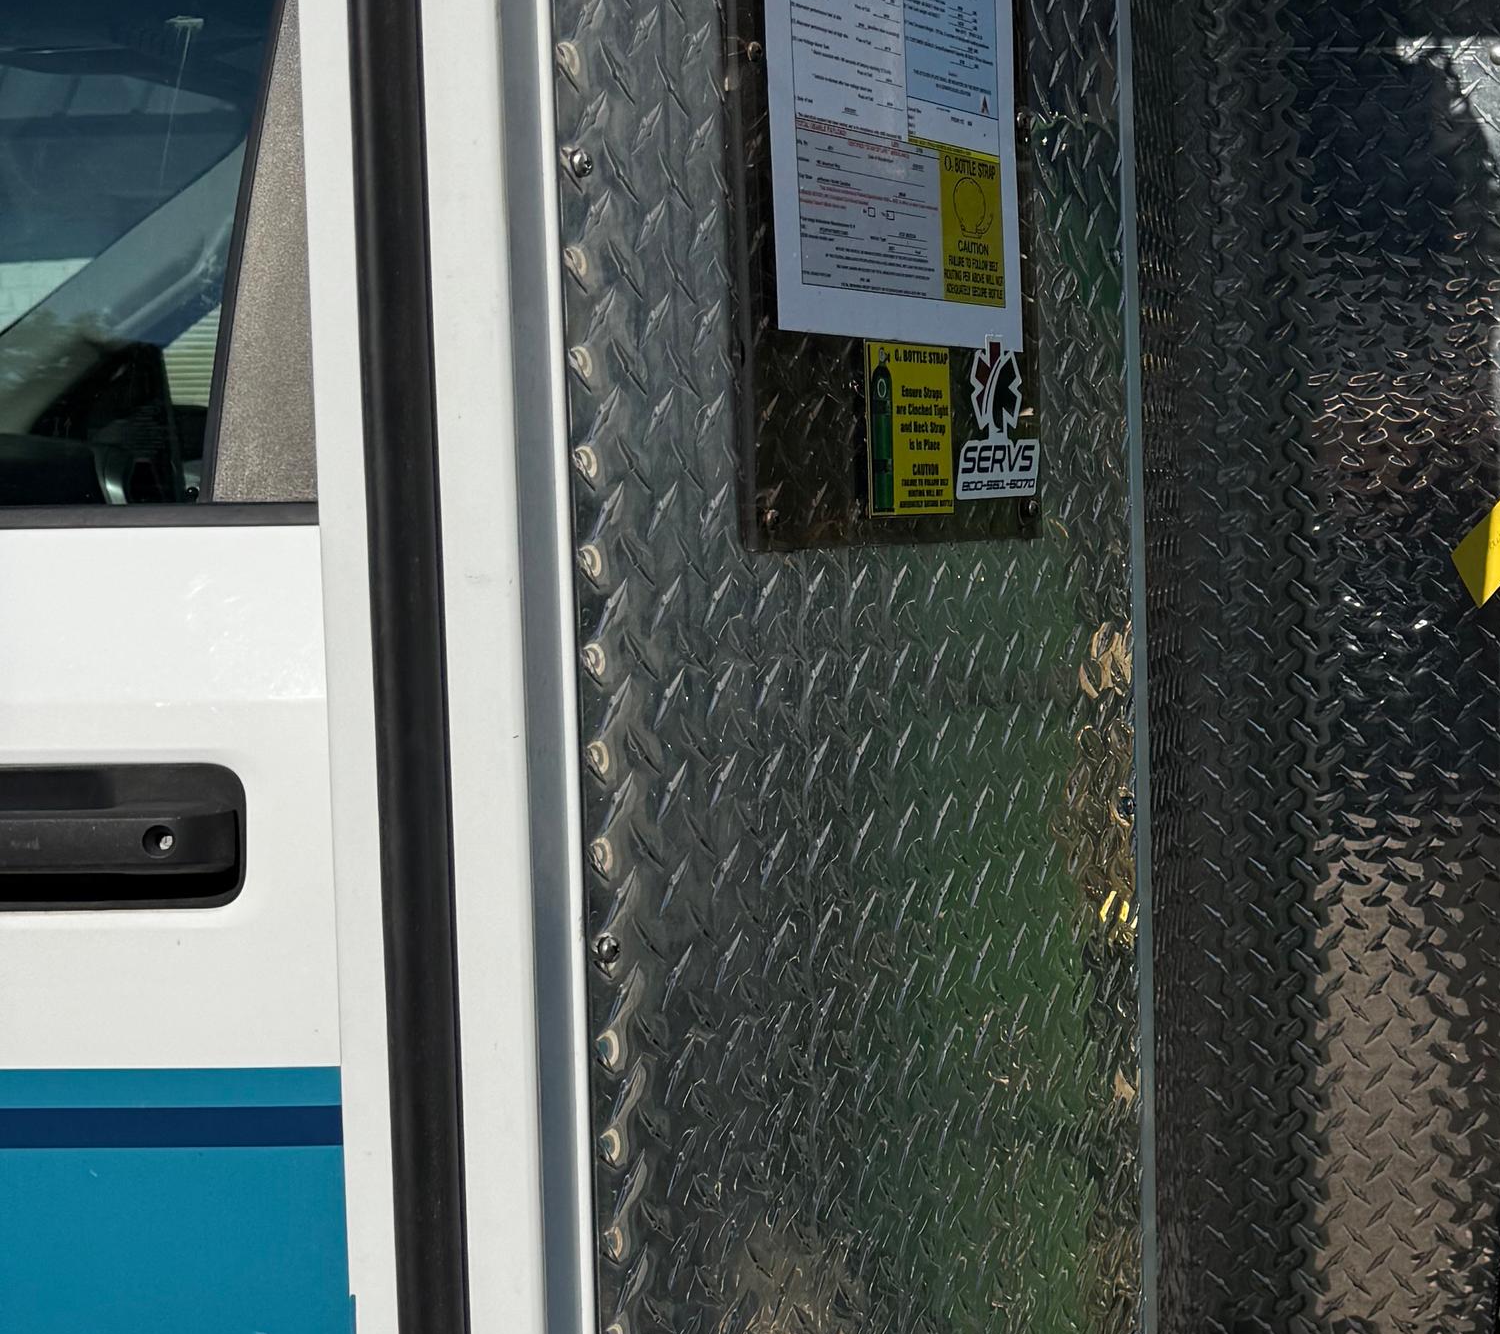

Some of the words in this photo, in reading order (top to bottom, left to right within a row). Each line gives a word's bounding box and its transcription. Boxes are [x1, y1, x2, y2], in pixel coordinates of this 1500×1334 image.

[955, 157, 976, 177] BOTTLE
[977, 162, 996, 180] STRAP
[958, 240, 989, 255] CAUTION
[948, 255, 965, 267] FAILURE
[965, 257, 971, 268] TO
[903, 349, 927, 364] BOTTLE
[928, 350, 948, 365] STRAP
[902, 385, 922, 398] Ensure
[923, 386, 943, 401] Straps
[896, 406, 907, 415] are
[908, 403, 932, 416] Cinched
[933, 404, 949, 418] Tight
[900, 422, 912, 433] and
[912, 422, 929, 433] Neck
[929, 422, 946, 435] Strap
[909, 438, 915, 451] is
[923, 439, 941, 451] Place
[961, 444, 1036, 474] SERVS
[912, 463, 939, 476] CAUTION
